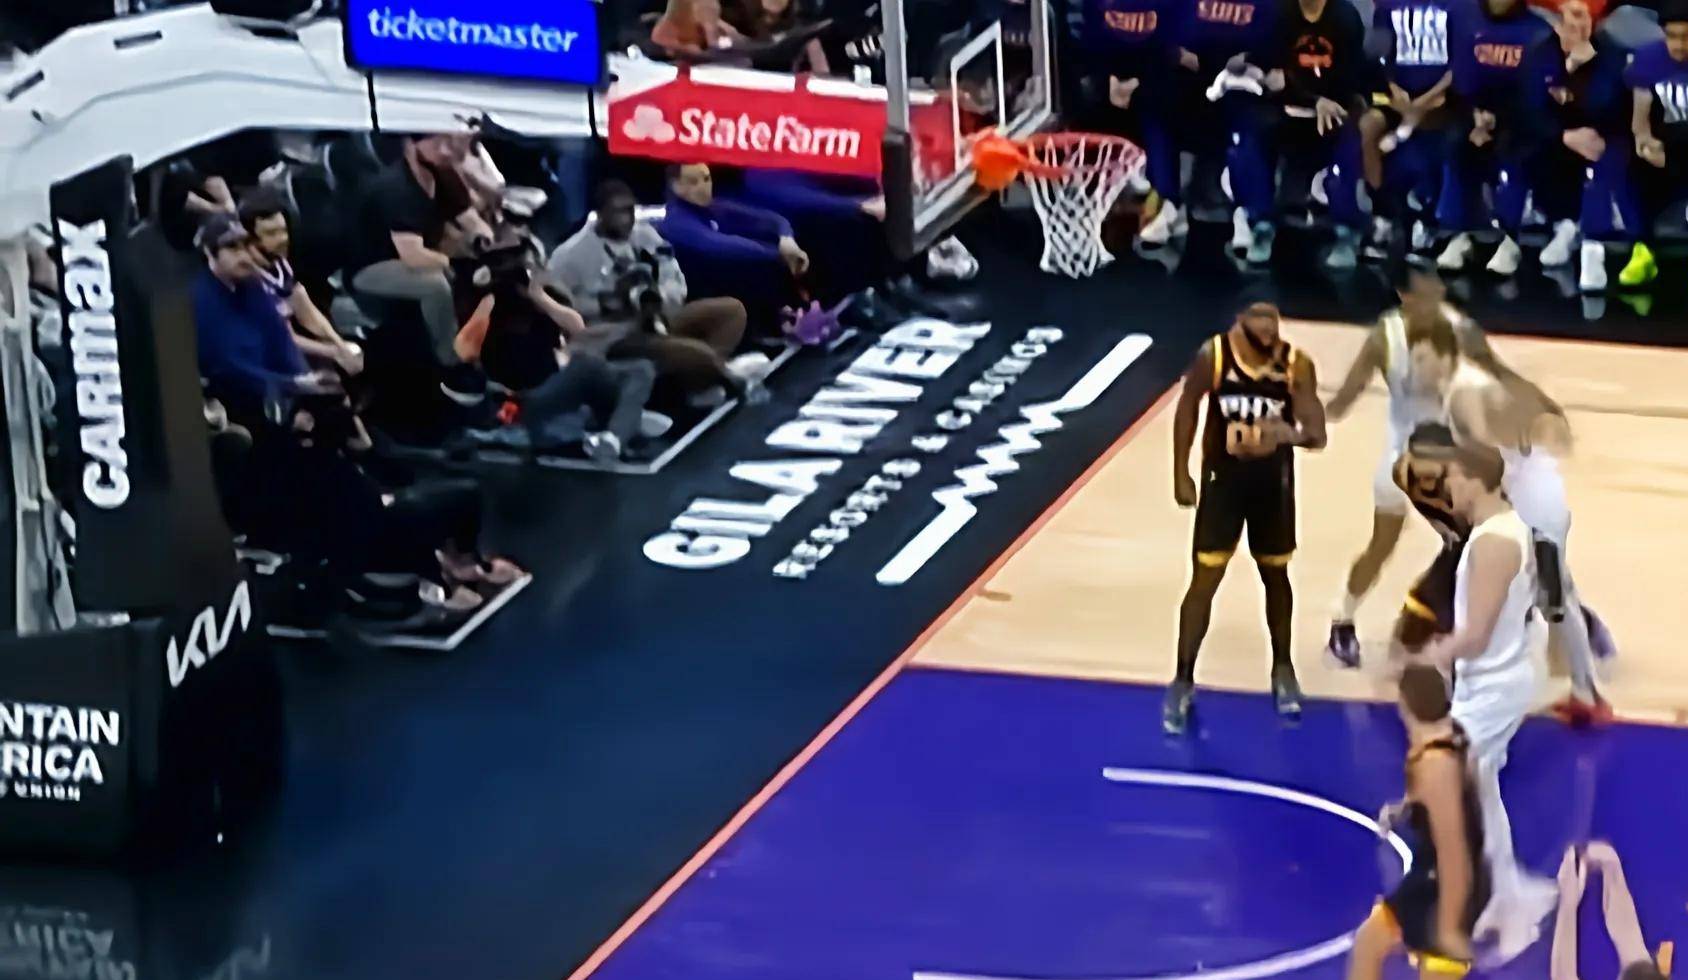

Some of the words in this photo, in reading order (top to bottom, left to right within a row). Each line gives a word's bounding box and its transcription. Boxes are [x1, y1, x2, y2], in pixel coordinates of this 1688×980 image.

[367, 6, 579, 54] ticketmaster
[643, 458, 843, 569] GILA
[765, 317, 992, 454] RIVER
[0, 701, 120, 747] NTAIN
